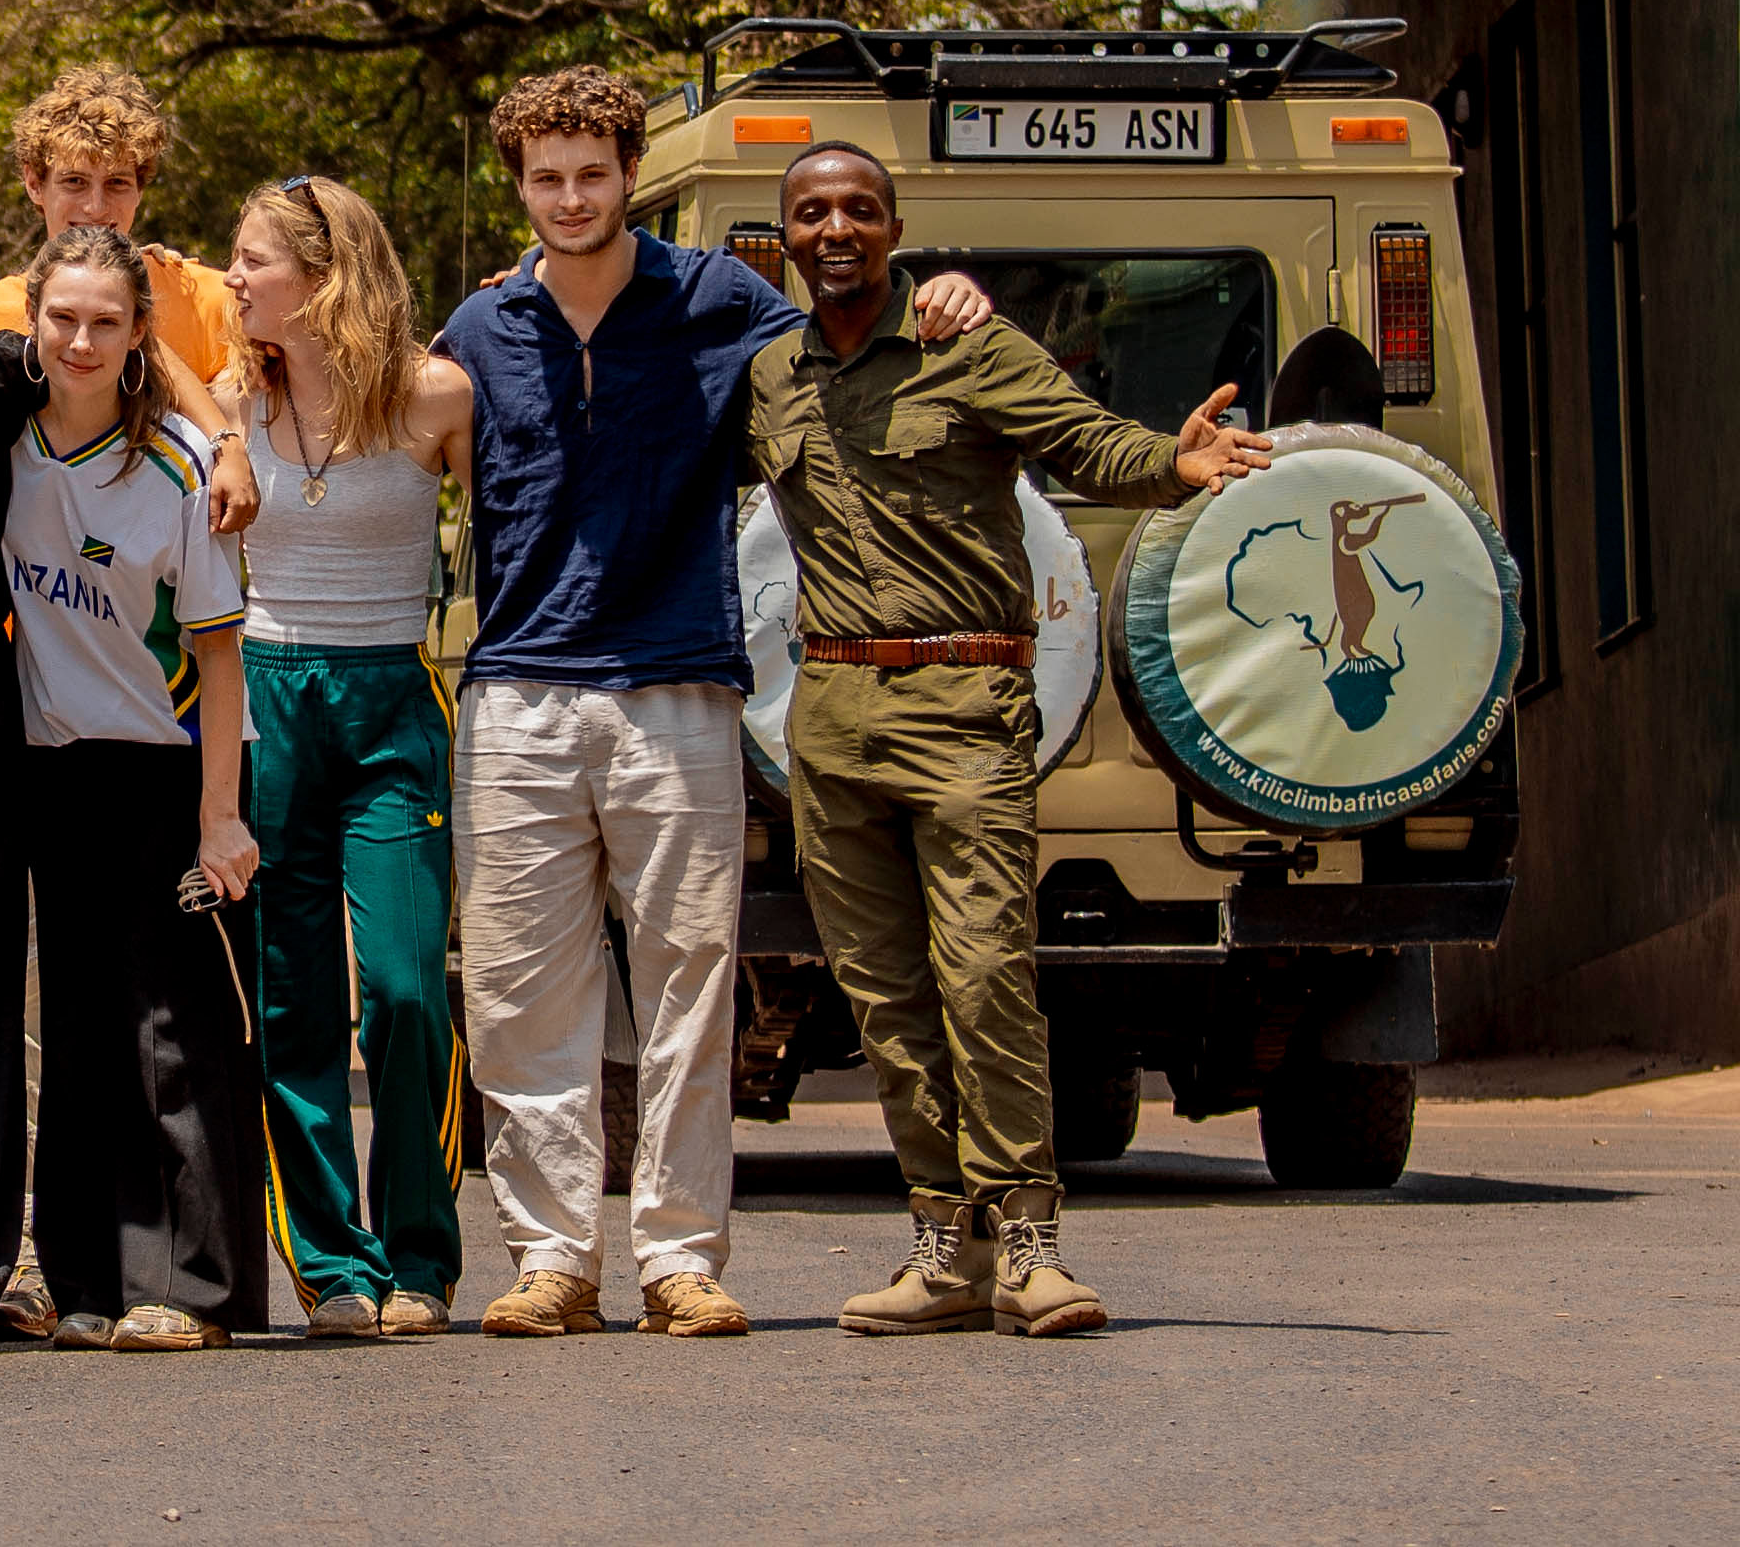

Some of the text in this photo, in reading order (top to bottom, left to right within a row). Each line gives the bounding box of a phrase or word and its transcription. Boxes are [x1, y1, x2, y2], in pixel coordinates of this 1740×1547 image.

[981, 108, 1200, 150] T 645 ASN
[1196, 696, 1506, 813] www.kiliclimbafricasafaris.com
